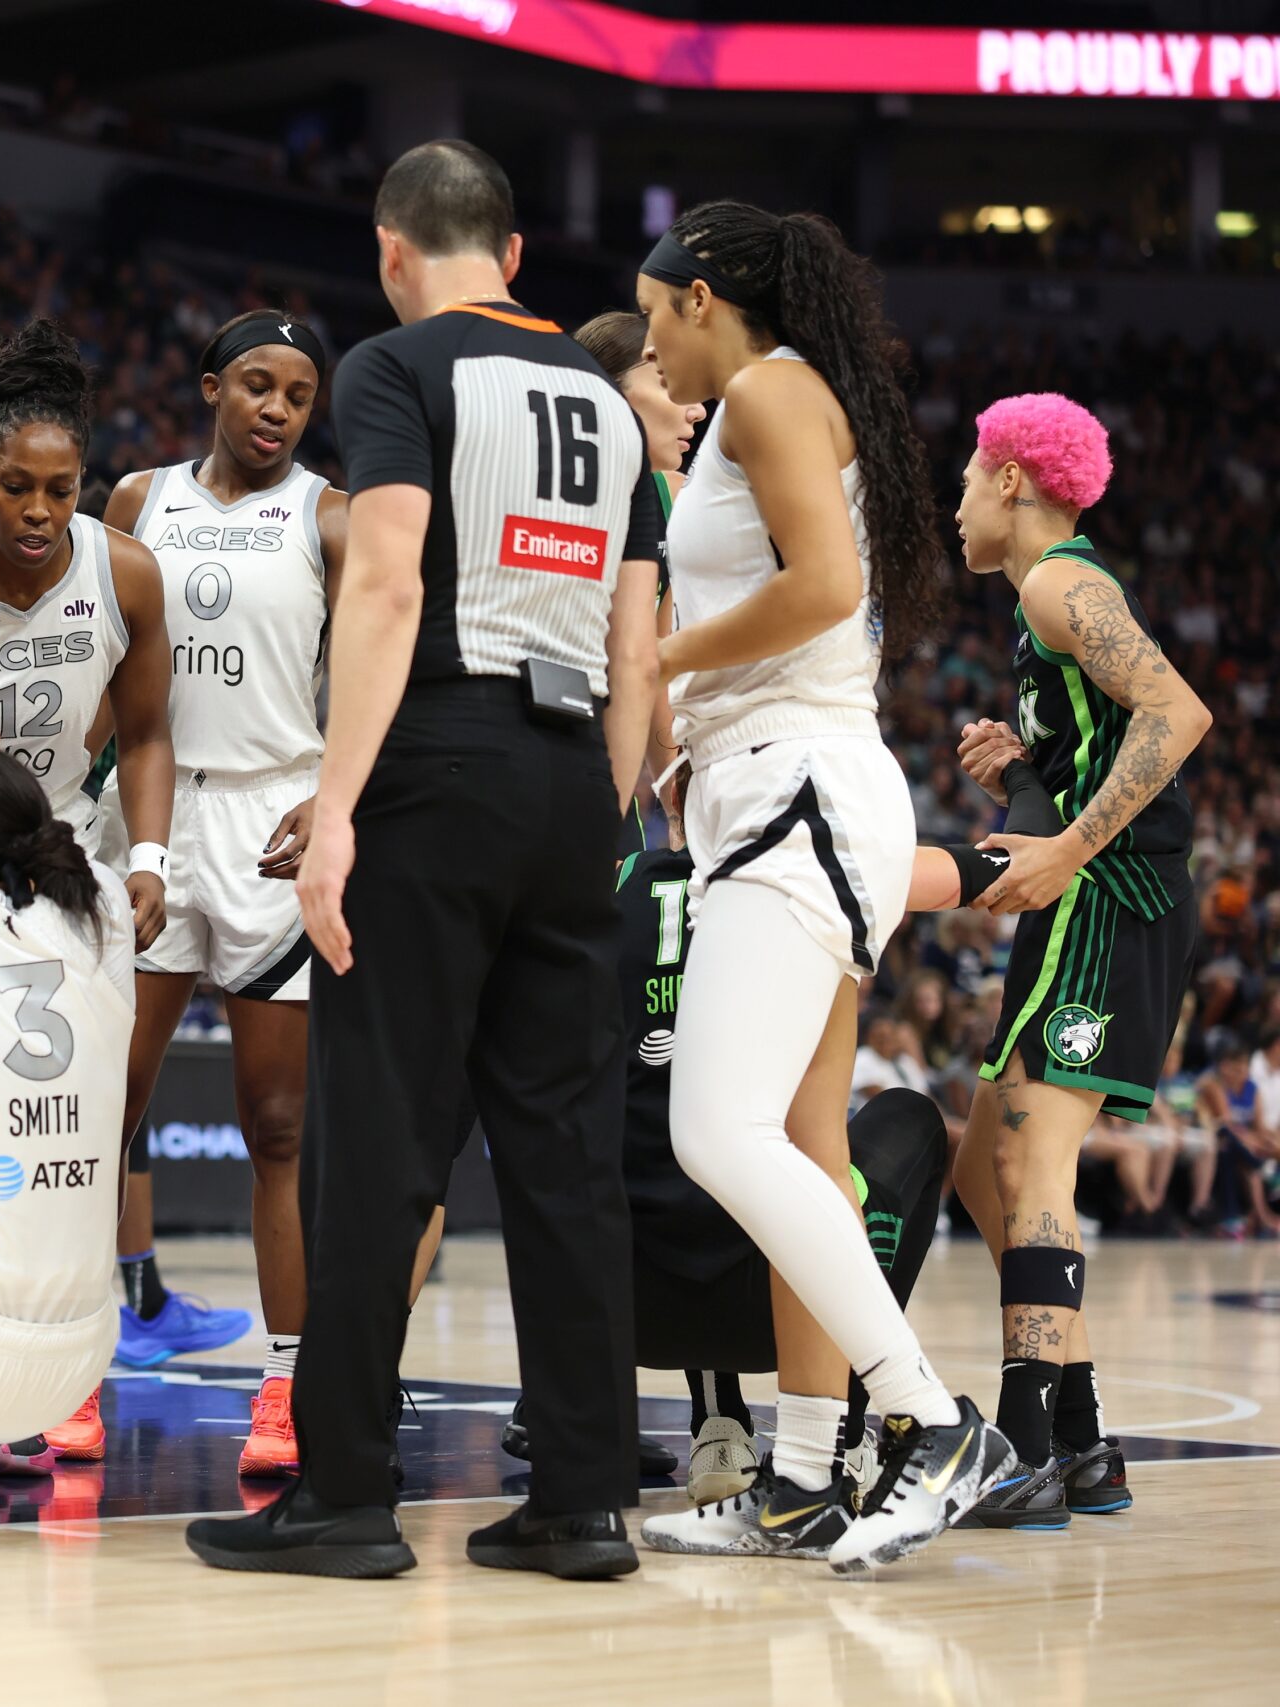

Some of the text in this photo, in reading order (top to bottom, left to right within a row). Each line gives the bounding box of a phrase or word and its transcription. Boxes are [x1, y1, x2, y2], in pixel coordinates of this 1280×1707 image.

[977, 29, 1280, 99] PROUDLY PO
[527, 389, 599, 507] 16
[259, 507, 291, 522] ally
[153, 523, 285, 552] ACES
[513, 528, 599, 566] Emirates
[63, 600, 96, 618] ally
[185, 561, 232, 621] 0
[173, 635, 244, 687] ring
[9, 1095, 79, 1137] SMITH
[31, 1158, 100, 1190] AT&T
